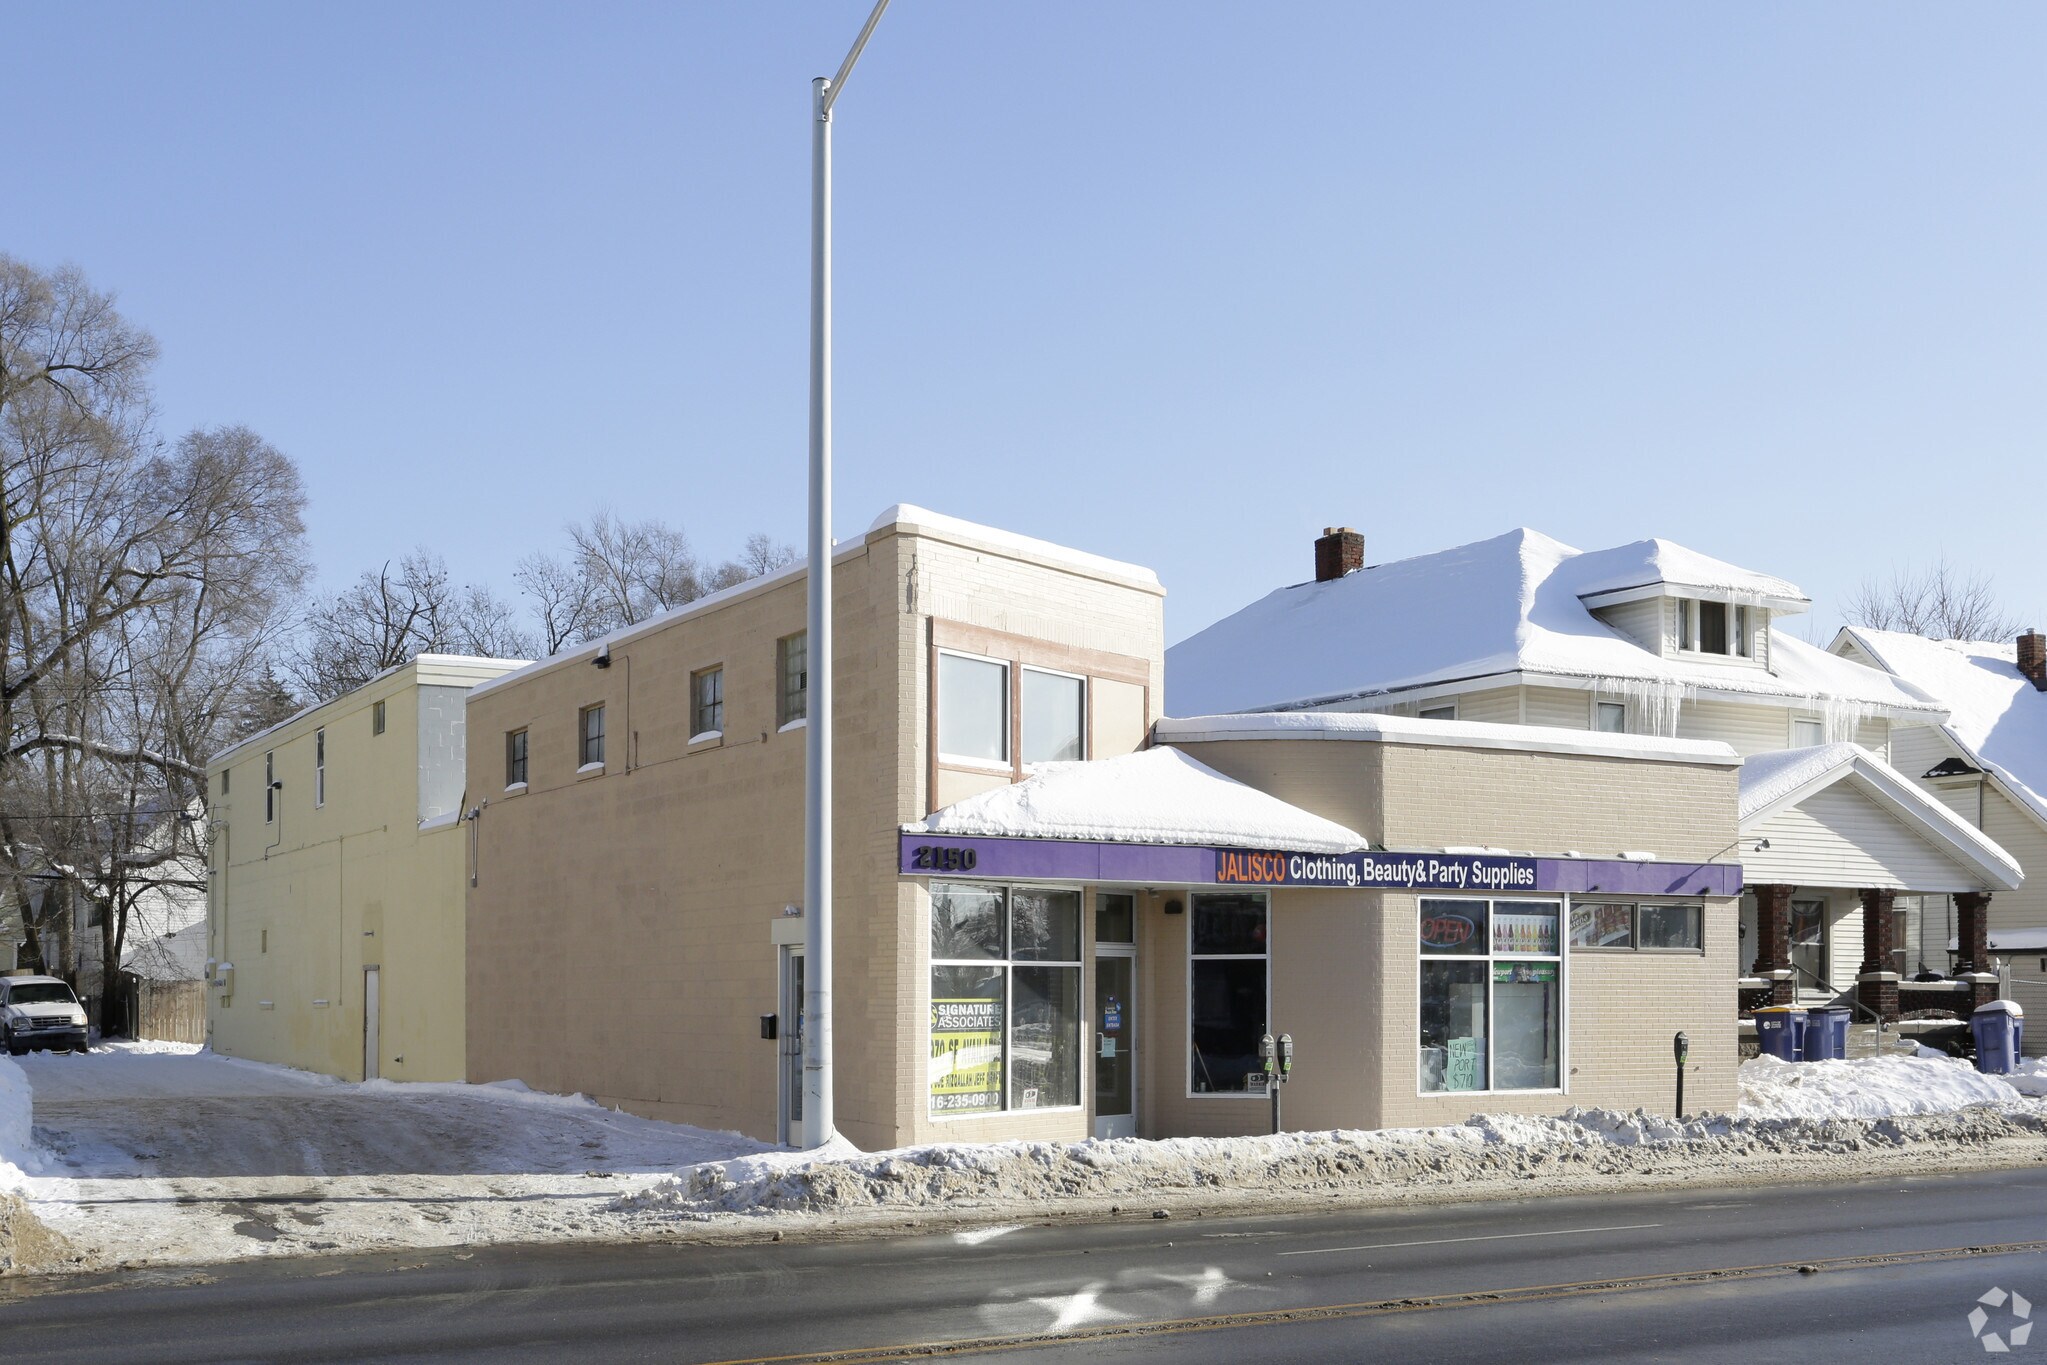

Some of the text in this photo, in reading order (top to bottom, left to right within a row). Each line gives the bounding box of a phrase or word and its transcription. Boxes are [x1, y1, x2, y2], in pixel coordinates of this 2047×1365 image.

[917, 846, 976, 870] 2150
[1218, 851, 1286, 882] JALISCO
[1290, 856, 1360, 886] Clothing,
[1430, 860, 1468, 888] Party
[1472, 860, 1534, 889] Supplies
[1420, 917, 1470, 944] OPEN
[938, 1004, 1000, 1016] SIGNATURE
[938, 1016, 1000, 1028] ASSOCIATES
[1454, 1058, 1476, 1071] PORT
